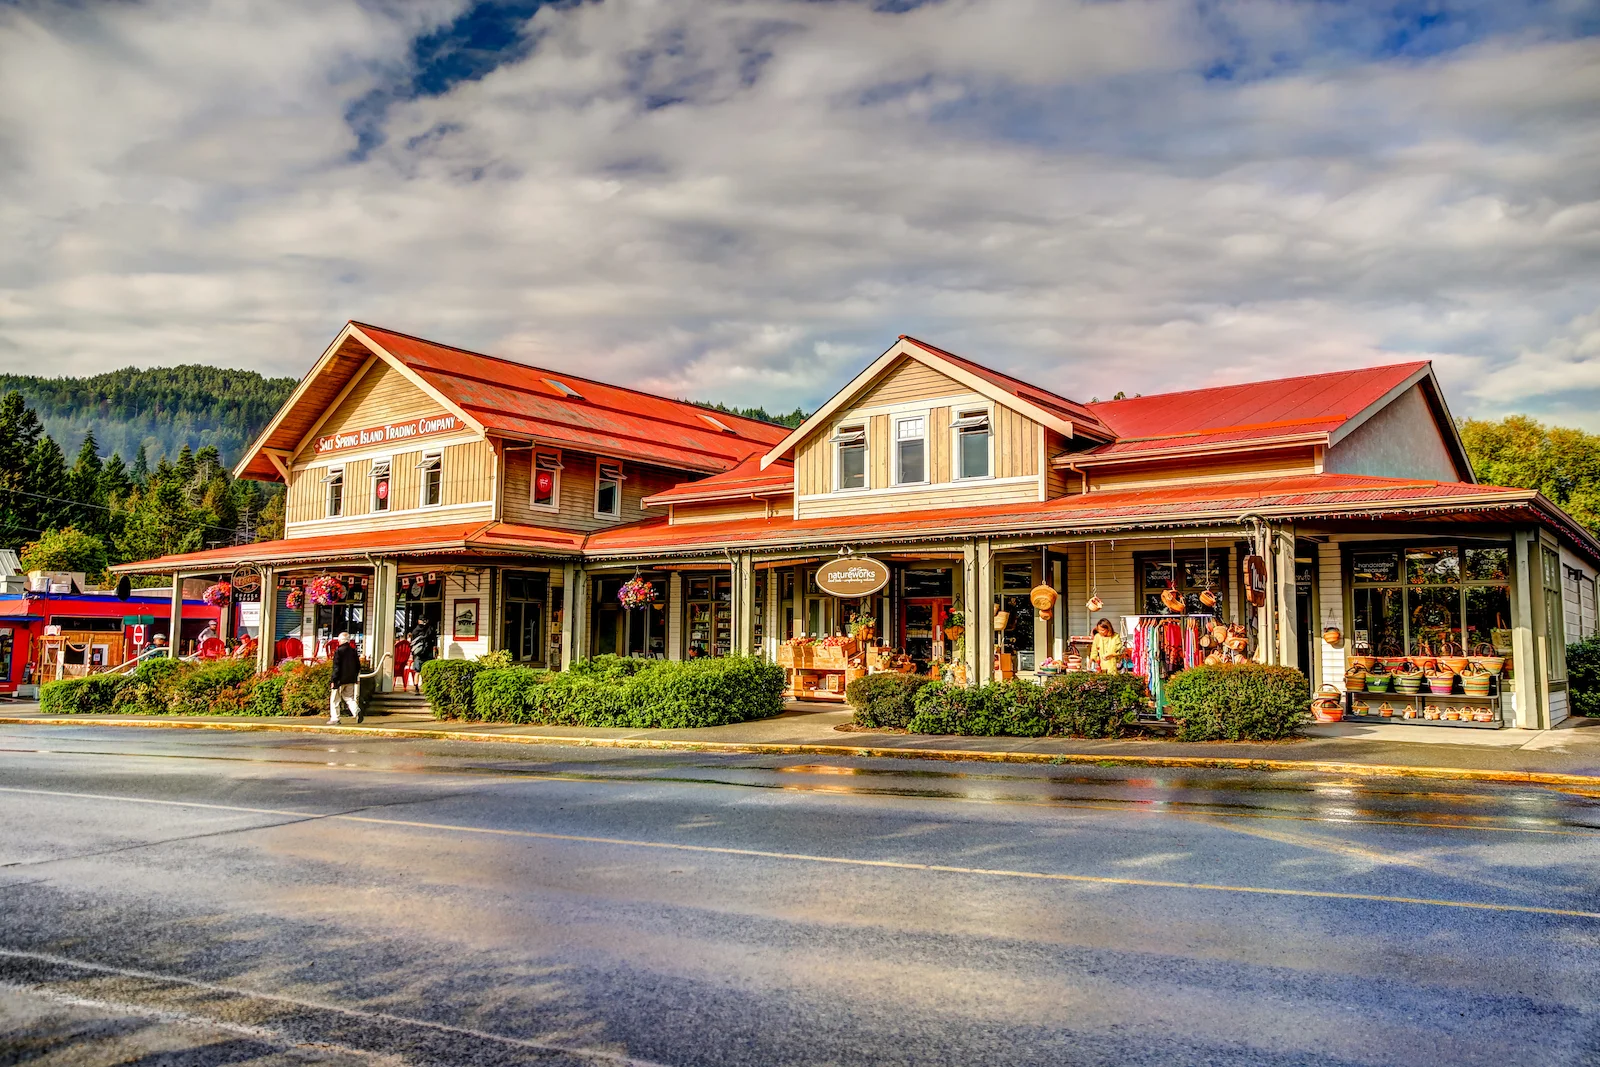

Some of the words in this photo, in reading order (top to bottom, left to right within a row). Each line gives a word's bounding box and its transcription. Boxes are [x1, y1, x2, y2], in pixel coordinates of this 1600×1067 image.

[319, 437, 334, 452] SALT
[335, 434, 359, 449] SPRING
[360, 430, 384, 445] ISLAND
[385, 425, 417, 440] TRADING
[418, 416, 457, 434] COMPANY
[827, 570, 876, 578] natureworks
